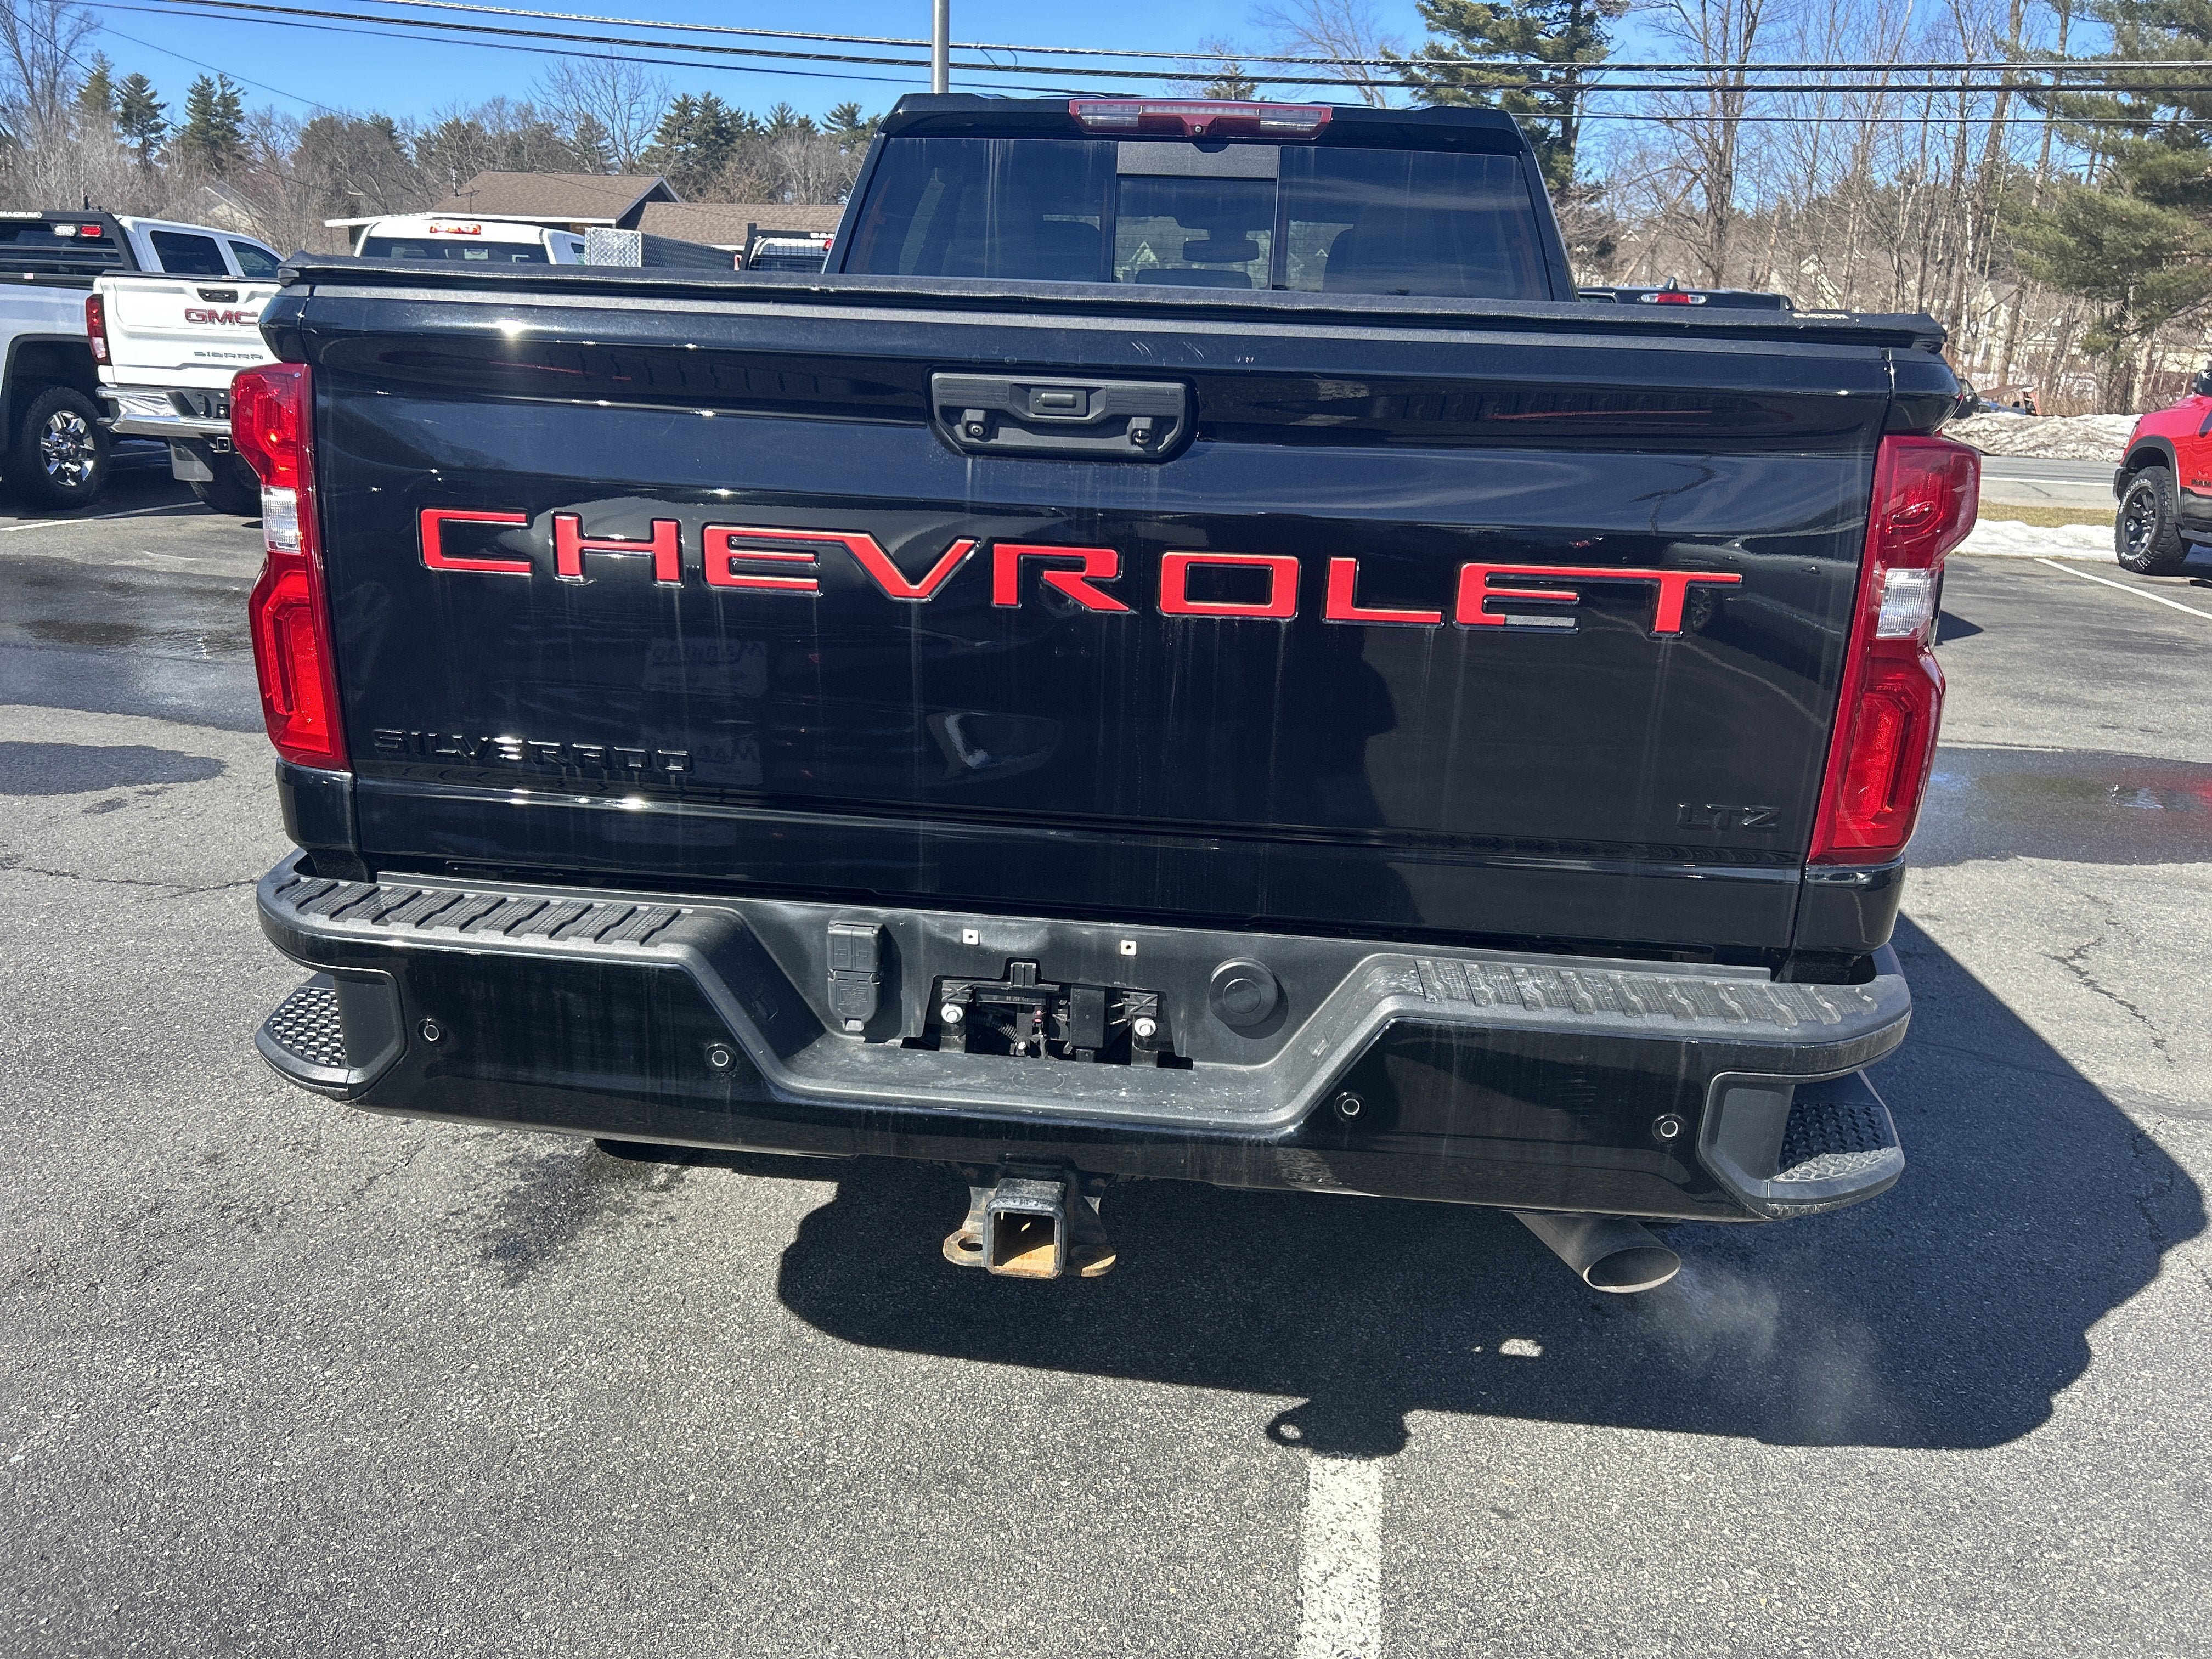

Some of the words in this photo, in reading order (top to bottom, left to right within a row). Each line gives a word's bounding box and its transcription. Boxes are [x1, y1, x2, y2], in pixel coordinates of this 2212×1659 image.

[184, 308, 258, 326] GMC
[194, 351, 263, 359] SIERRA
[417, 506, 1745, 637] CHEVROLET
[373, 728, 693, 775] SILVERADO
[1676, 802, 1780, 833] LTZ
